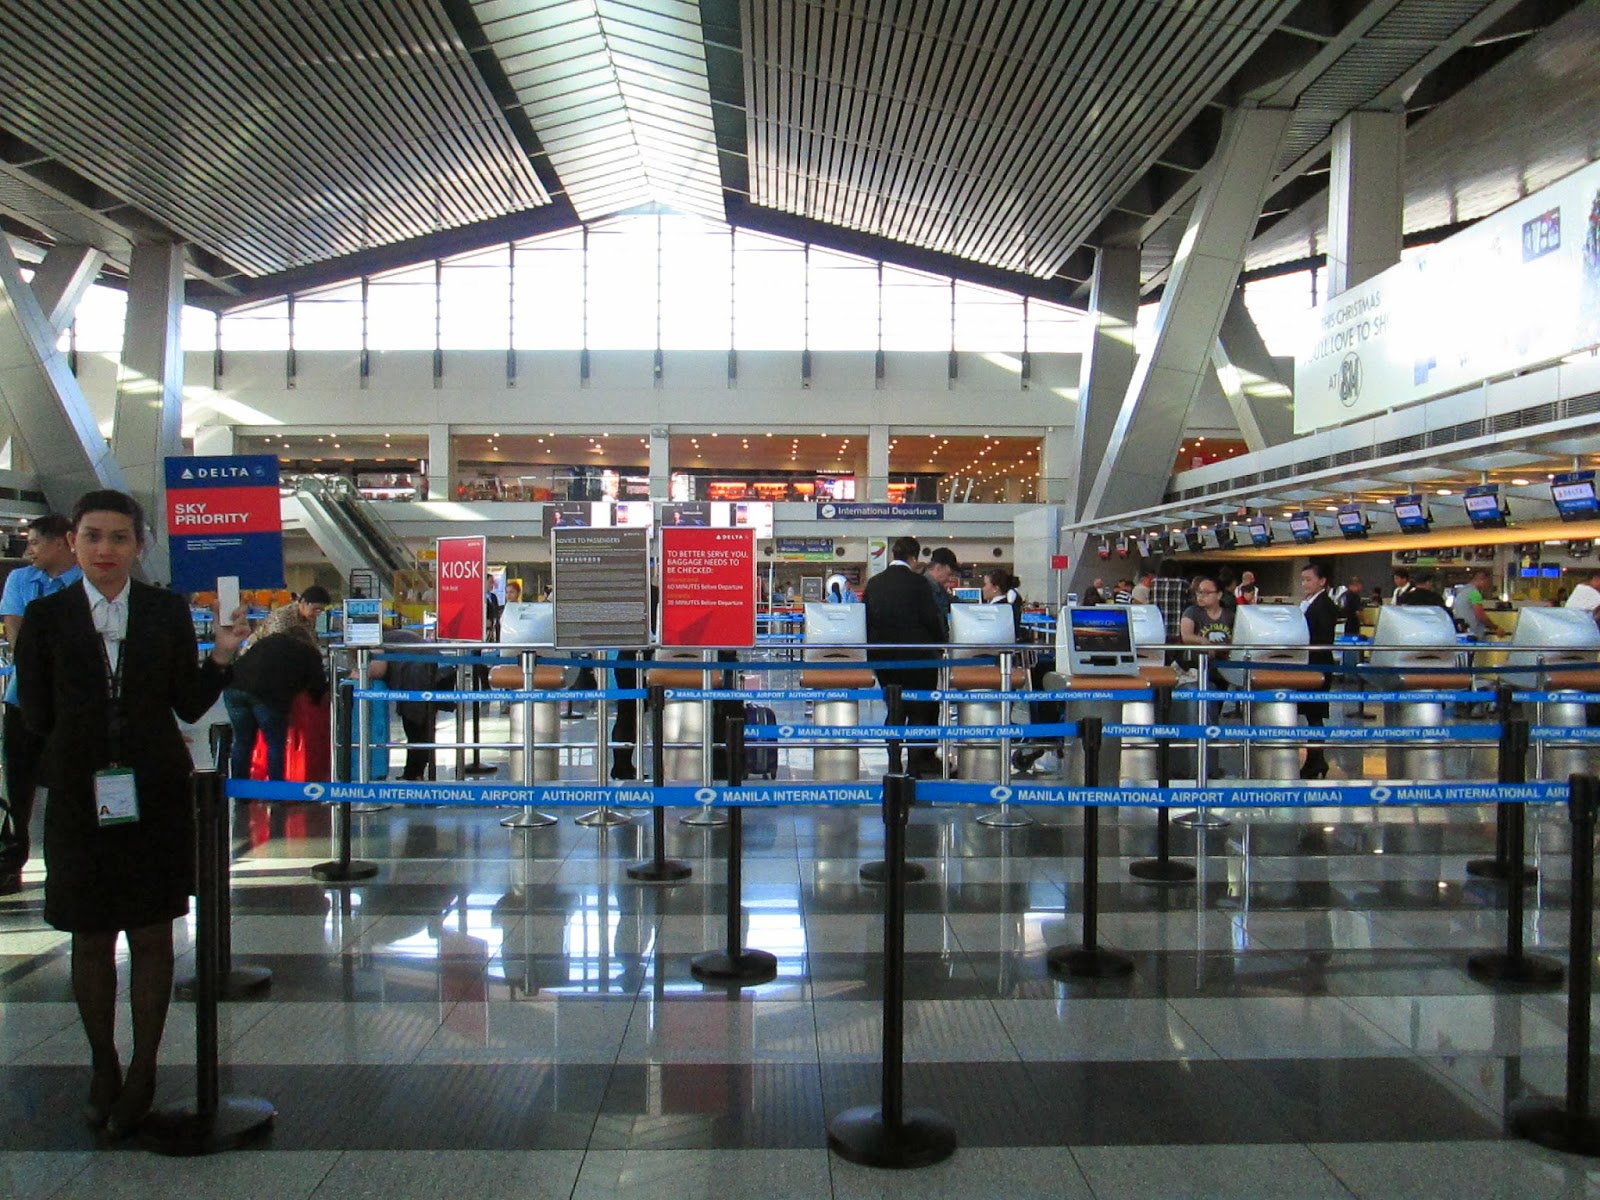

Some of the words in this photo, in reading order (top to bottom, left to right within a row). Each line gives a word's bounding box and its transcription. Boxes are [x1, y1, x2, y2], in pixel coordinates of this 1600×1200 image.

[1336, 290, 1381, 325] CHRISTMAS
[1330, 326, 1354, 354] LOVE
[1357, 321, 1370, 342] TO
[198, 467, 249, 478] DELTA
[175, 503, 207, 514] SKY
[838, 507, 890, 516] International
[892, 506, 938, 516] Departures
[175, 513, 249, 525] PRIORITY
[441, 560, 480, 579] KIOSK
[702, 691, 754, 699] INTERNATIONAL
[1314, 692, 1366, 700] INTERNATIONAL
[1368, 692, 1396, 700] AIRPORT
[1399, 692, 1434, 700] AUTHORITY
[798, 728, 831, 737] MANILA
[832, 727, 900, 737] INTERNATIONAL
[904, 728, 941, 737] AIRPORT
[947, 728, 994, 736] AUTHORITY
[996, 727, 1024, 737] (MIAA)
[1102, 726, 1150, 735] AUTHORITY
[1152, 727, 1180, 737] (MIAA)
[1225, 728, 1258, 737] MANILA
[1259, 728, 1326, 738] INTERNATIONAL
[1330, 728, 1368, 738] AIRPORT
[1373, 728, 1420, 738] AUTHORITY
[1422, 728, 1451, 738] (MIAA)
[330, 786, 376, 799] MANILA
[379, 788, 475, 801] INTERNATIONAL
[481, 790, 535, 801] AIRPORT
[542, 790, 612, 802] AUTHORITY
[615, 791, 654, 803] (MIAA)
[722, 791, 771, 802] MANILA
[774, 789, 873, 802] INTERNATIONAL
[1018, 790, 1065, 802] MANILA
[1068, 791, 1165, 803] INTERNATIONAL
[1171, 792, 1224, 803] AIRPORT
[1232, 791, 1300, 803] AUTHORITY
[1303, 790, 1342, 803] (MIAA)
[1397, 788, 1442, 800] MANILA
[1446, 787, 1541, 800] INTERNATIONAL
